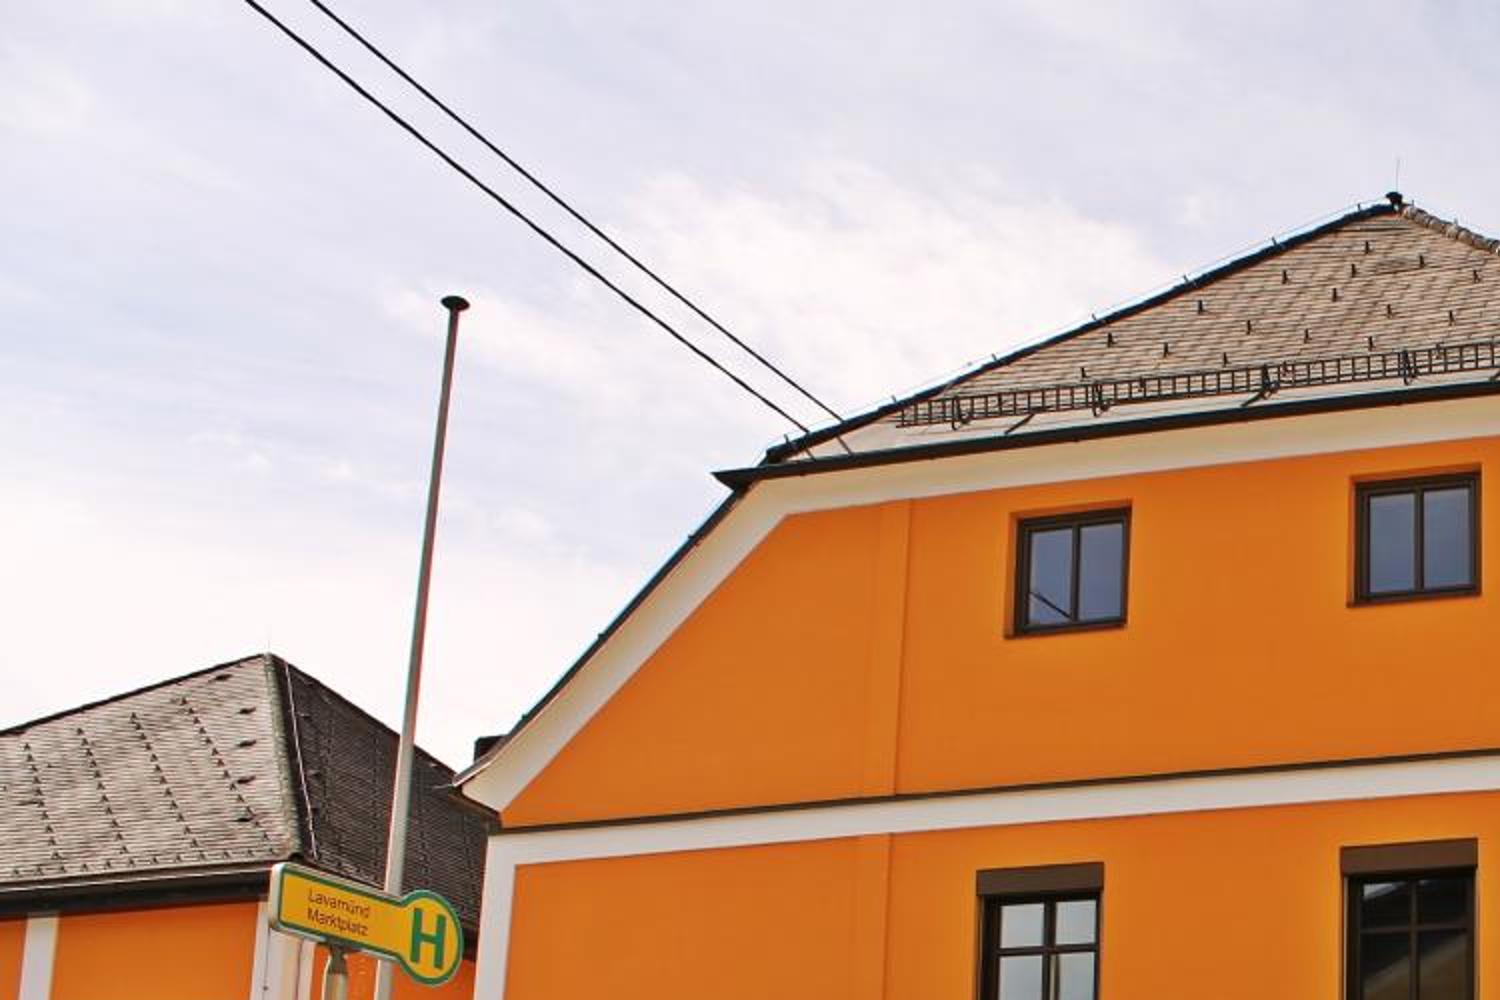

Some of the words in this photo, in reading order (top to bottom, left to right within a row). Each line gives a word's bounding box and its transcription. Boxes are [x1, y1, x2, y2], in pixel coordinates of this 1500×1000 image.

[308, 889, 369, 918] Lavamünd
[307, 907, 368, 936] Marktplatz
[410, 908, 447, 970] H
